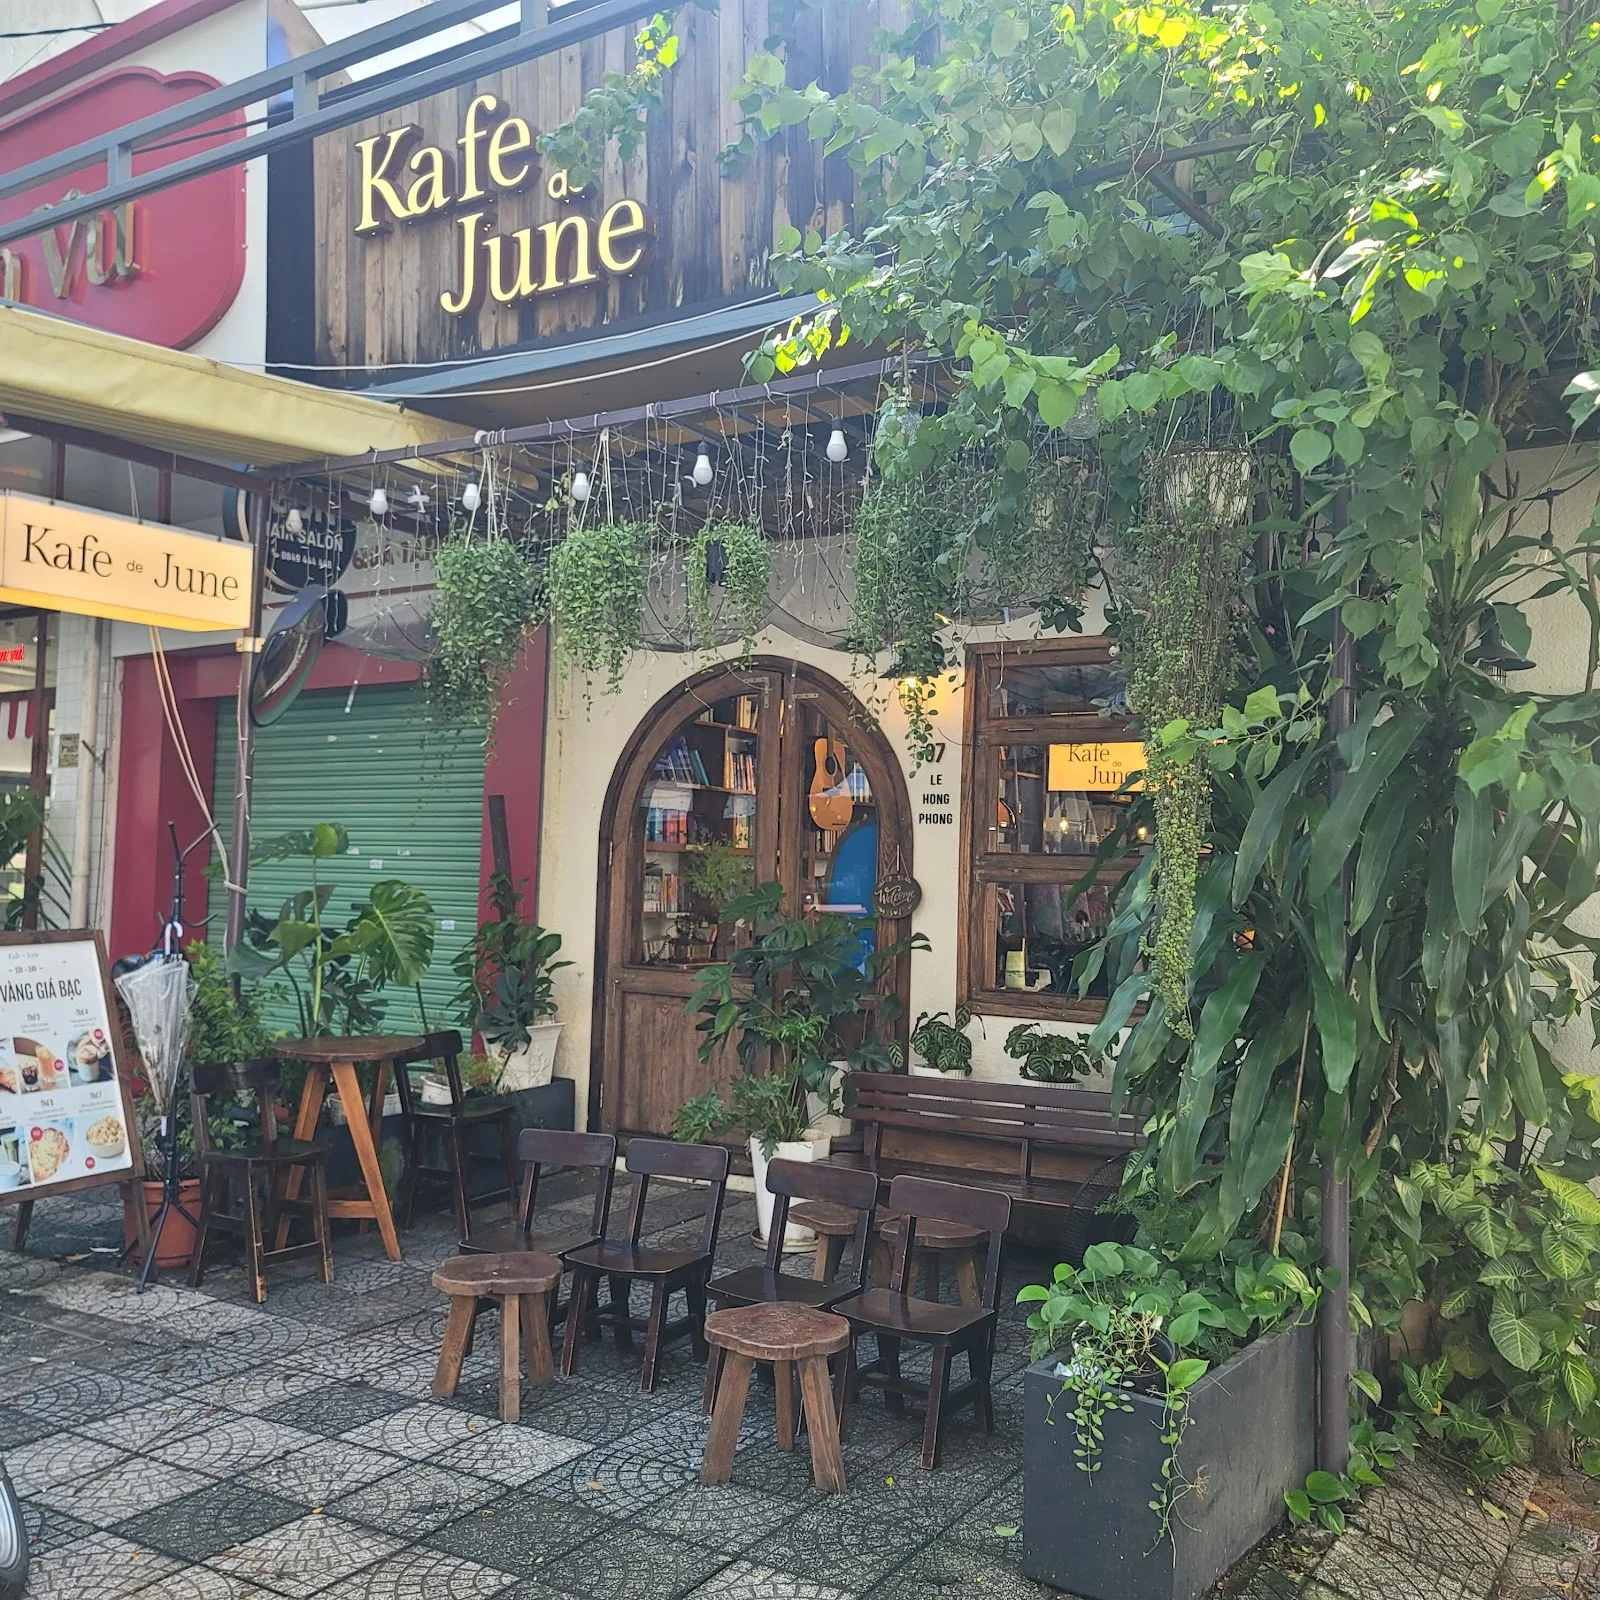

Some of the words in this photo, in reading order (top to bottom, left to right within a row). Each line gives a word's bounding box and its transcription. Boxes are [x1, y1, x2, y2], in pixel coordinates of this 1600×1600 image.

[354, 94, 531, 232] Kafe
[440, 199, 645, 314] June
[298, 529, 344, 552] SALON
[21, 522, 113, 578] Kafe
[126, 560, 144, 574] de
[153, 552, 239, 601] June
[1067, 743, 1110, 763] Kafe
[1112, 760, 1122, 768] de
[930, 774, 943, 786] LE
[922, 793, 950, 805] HONG
[918, 813, 953, 825] PHONG
[874, 885, 916, 907] Welcome
[36, 977, 57, 1000] GIÁ
[59, 978, 82, 1001] BẠC
